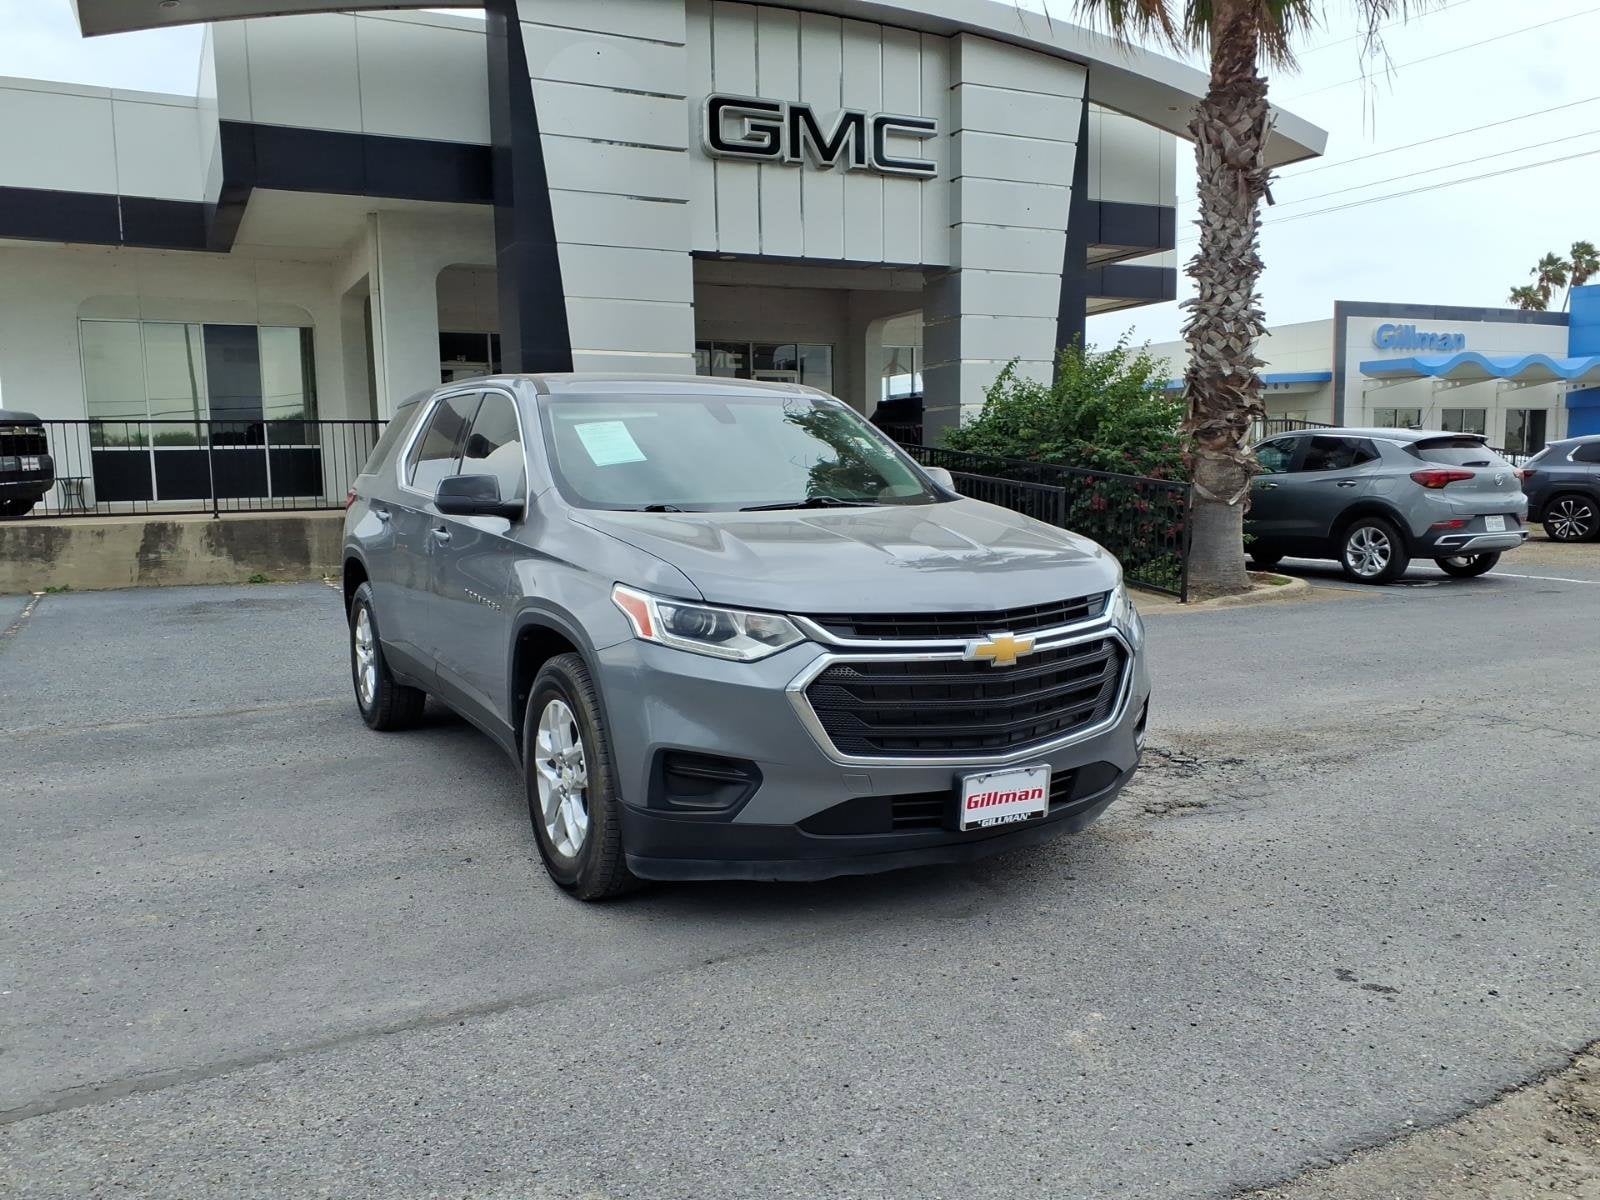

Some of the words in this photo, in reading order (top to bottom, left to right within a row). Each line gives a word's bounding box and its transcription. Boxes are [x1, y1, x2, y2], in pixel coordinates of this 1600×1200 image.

[703, 92, 937, 179] GMC
[1374, 323, 1465, 351] Gillman
[966, 787, 1043, 810] Gillman
[981, 813, 1028, 827] GILLMAN
